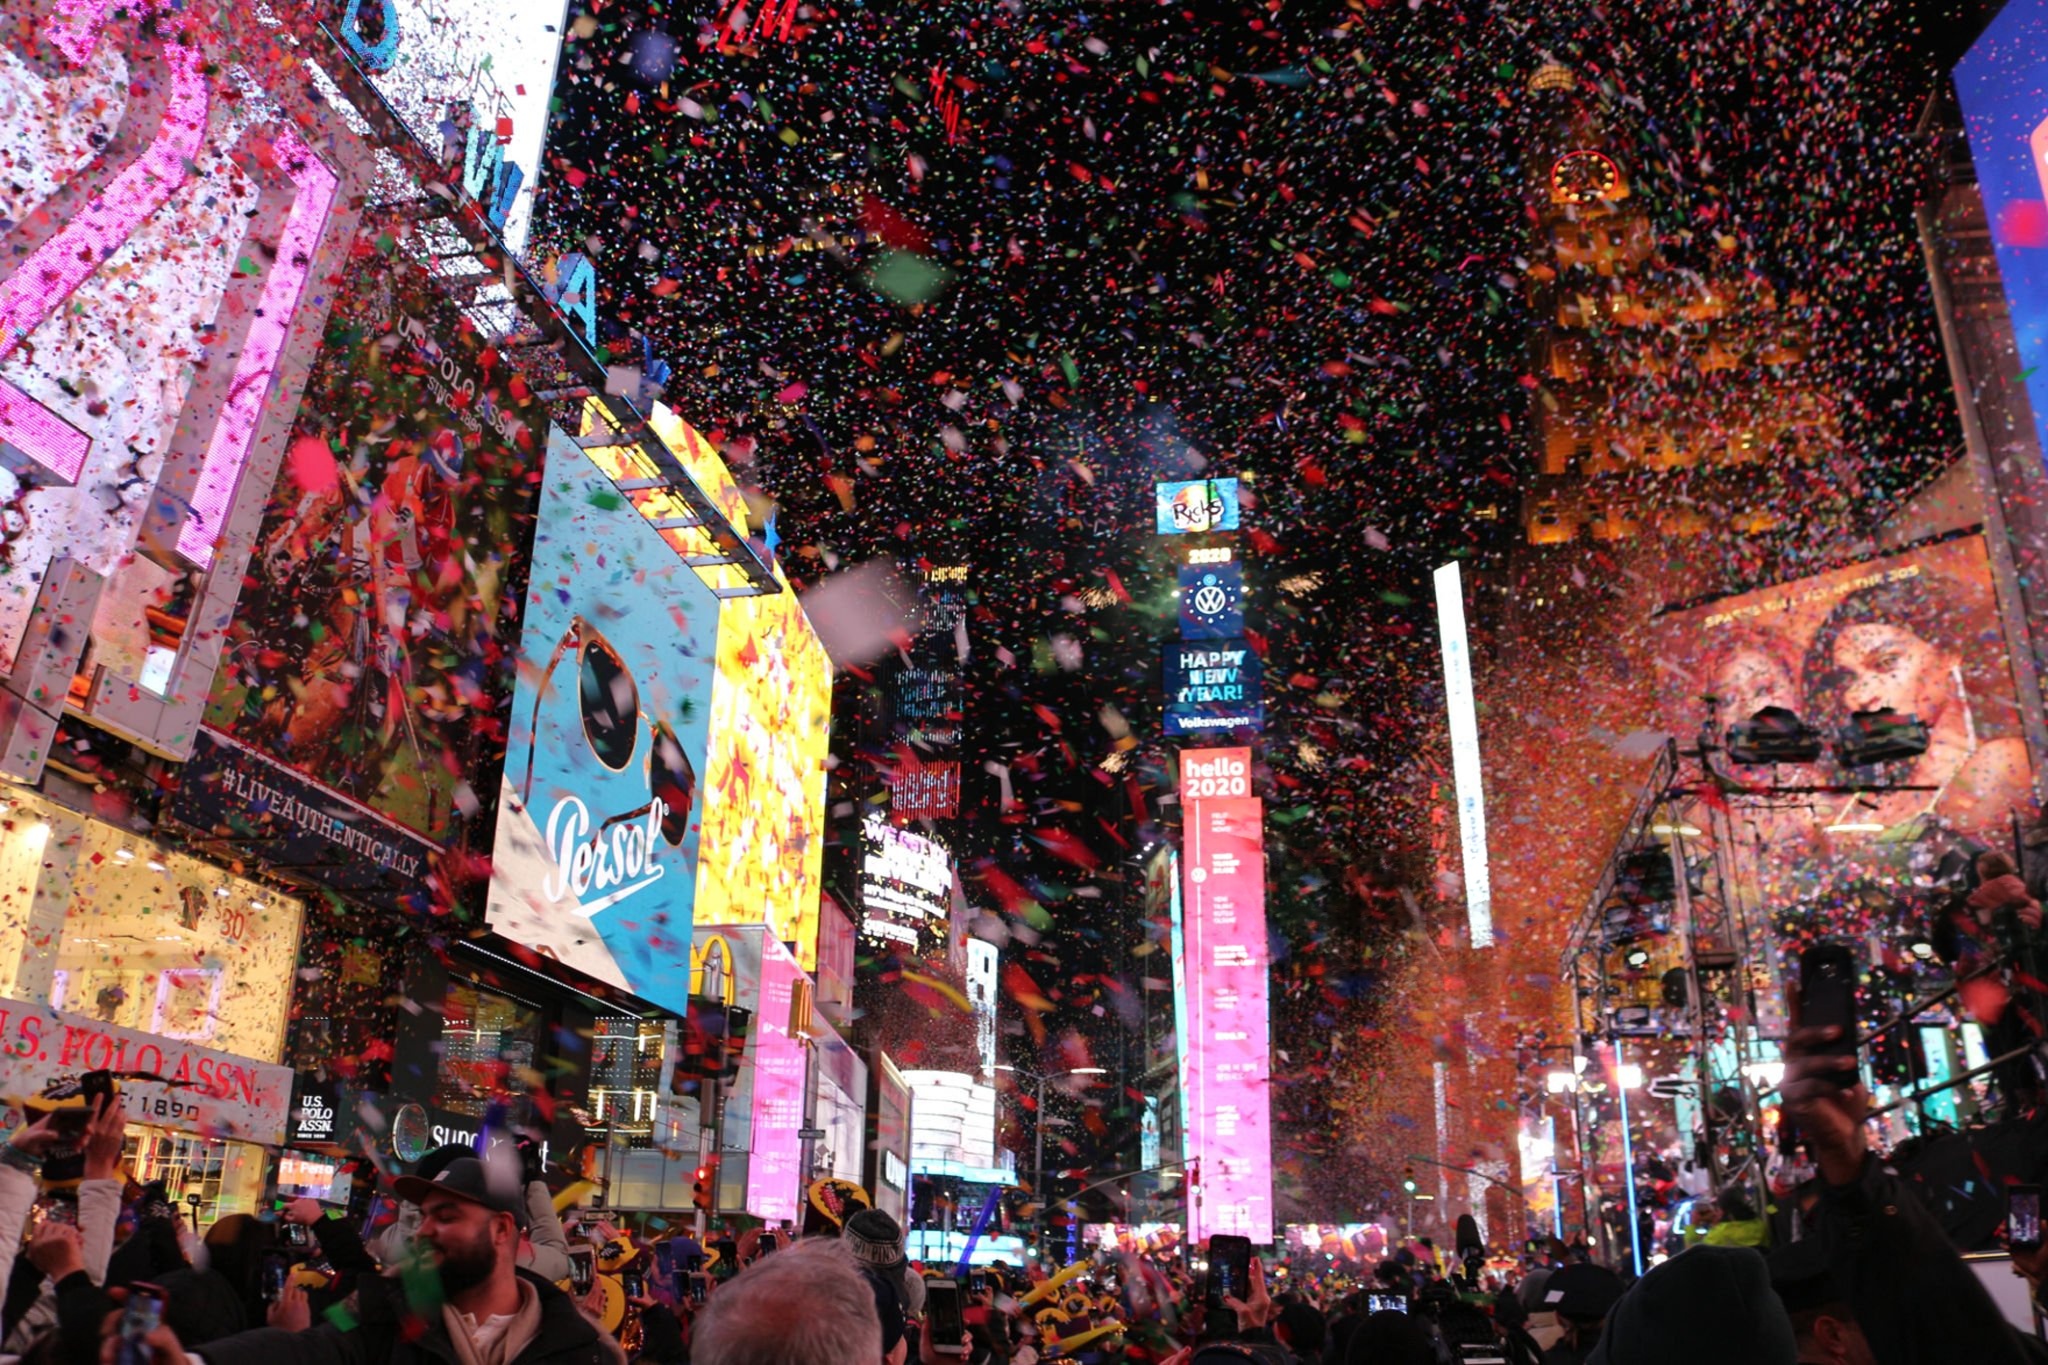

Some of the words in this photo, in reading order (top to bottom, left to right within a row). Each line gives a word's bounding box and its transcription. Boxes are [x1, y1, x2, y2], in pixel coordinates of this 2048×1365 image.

[1180, 651, 1246, 669] HAPPY
[1189, 667, 1239, 685] NEW
[1178, 685, 1243, 702] YEAR!
[1179, 716, 1250, 732] Volkswagen
[1185, 757, 1245, 778] hello
[1186, 777, 1246, 797] 2020
[542, 796, 664, 904] Persol
[57, 1024, 164, 1078] POLO
[171, 1053, 261, 1107] ASSN.
[141, 1095, 200, 1122] 1890
[303, 1096, 323, 1107] U.S.
[302, 1107, 333, 1120] POLO
[298, 1120, 333, 1132] ASSN.
